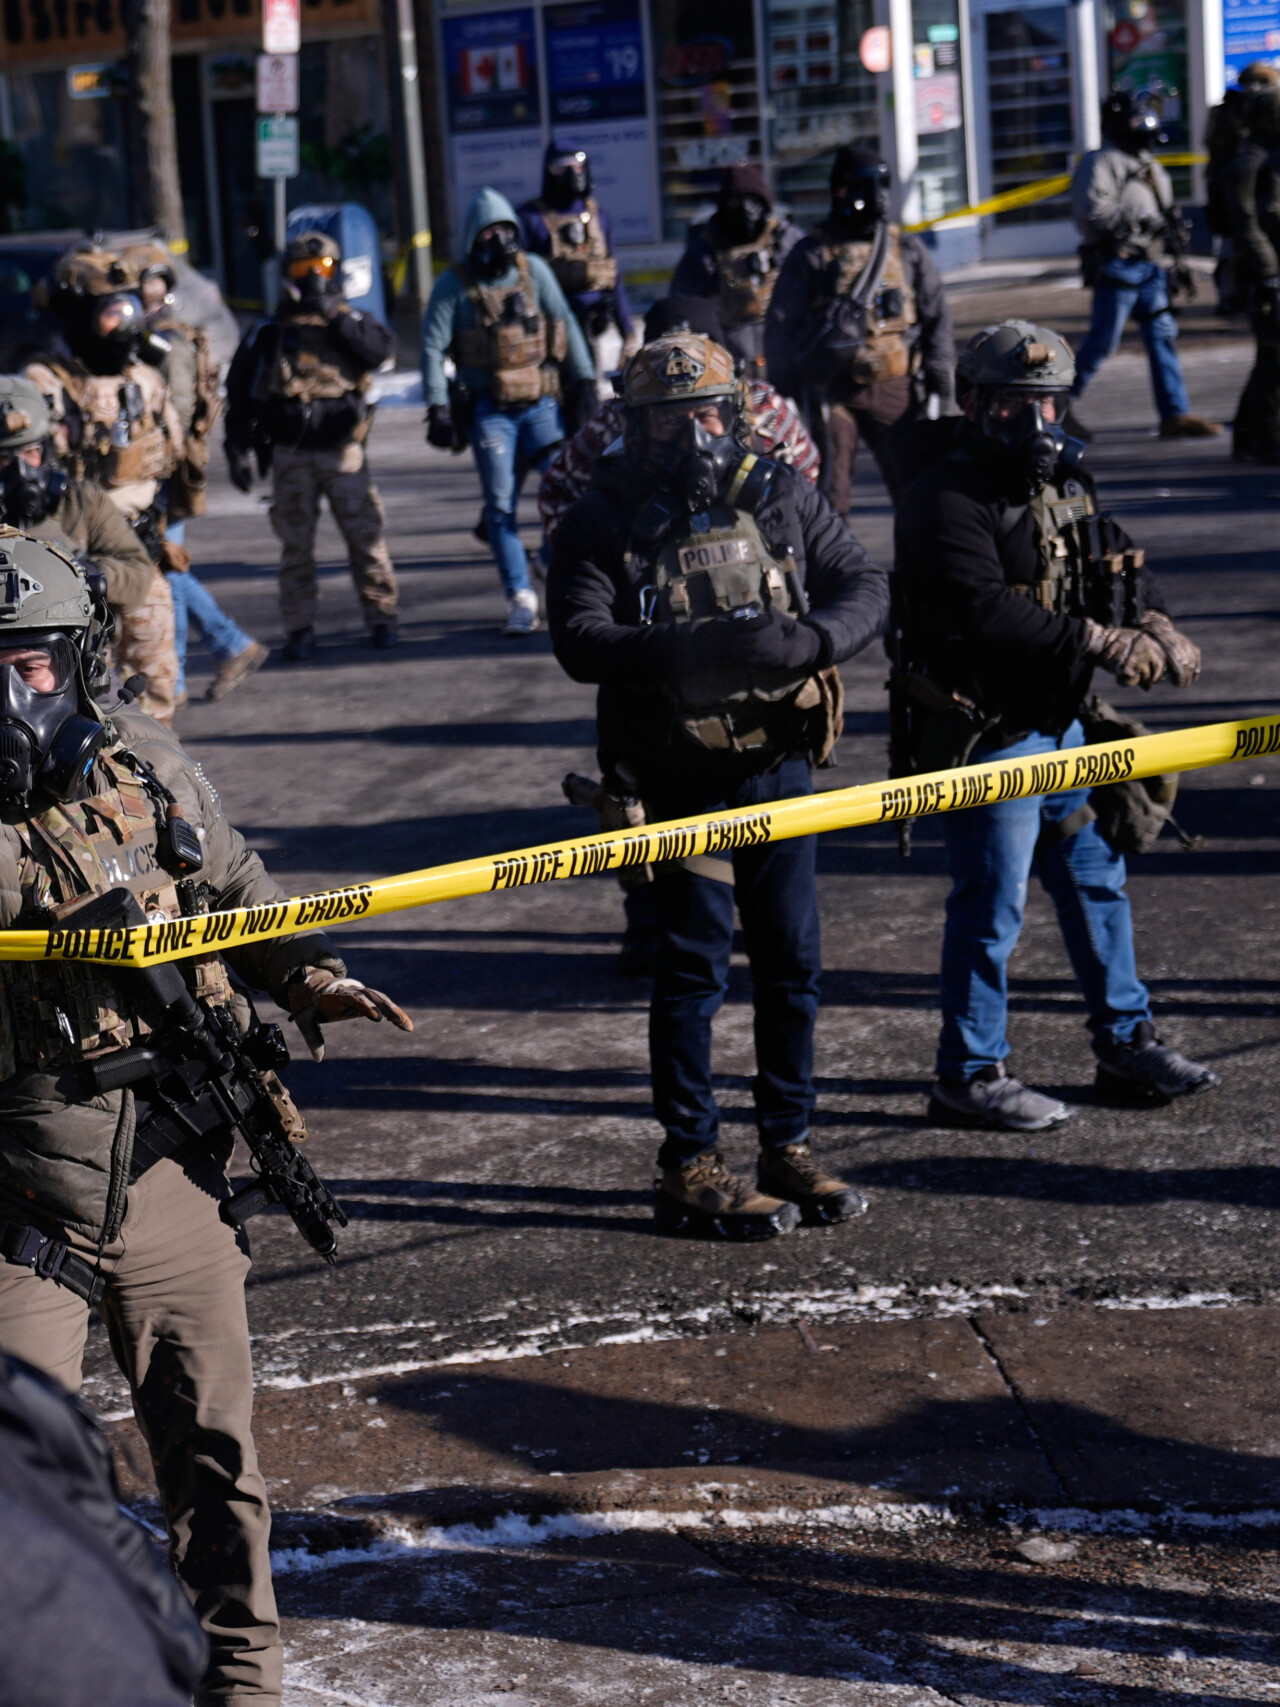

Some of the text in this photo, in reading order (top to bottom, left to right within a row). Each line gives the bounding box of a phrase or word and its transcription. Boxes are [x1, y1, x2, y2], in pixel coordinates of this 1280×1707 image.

[683, 541, 749, 570] POLICE
[878, 748, 1135, 821] POLICE LINE DO NOT CROSS
[100, 842, 161, 884] OLICE
[490, 811, 772, 891] POLICE LINE DO NOT CROSS
[44, 885, 373, 960] POLICE LINE DO NOT CROSS
